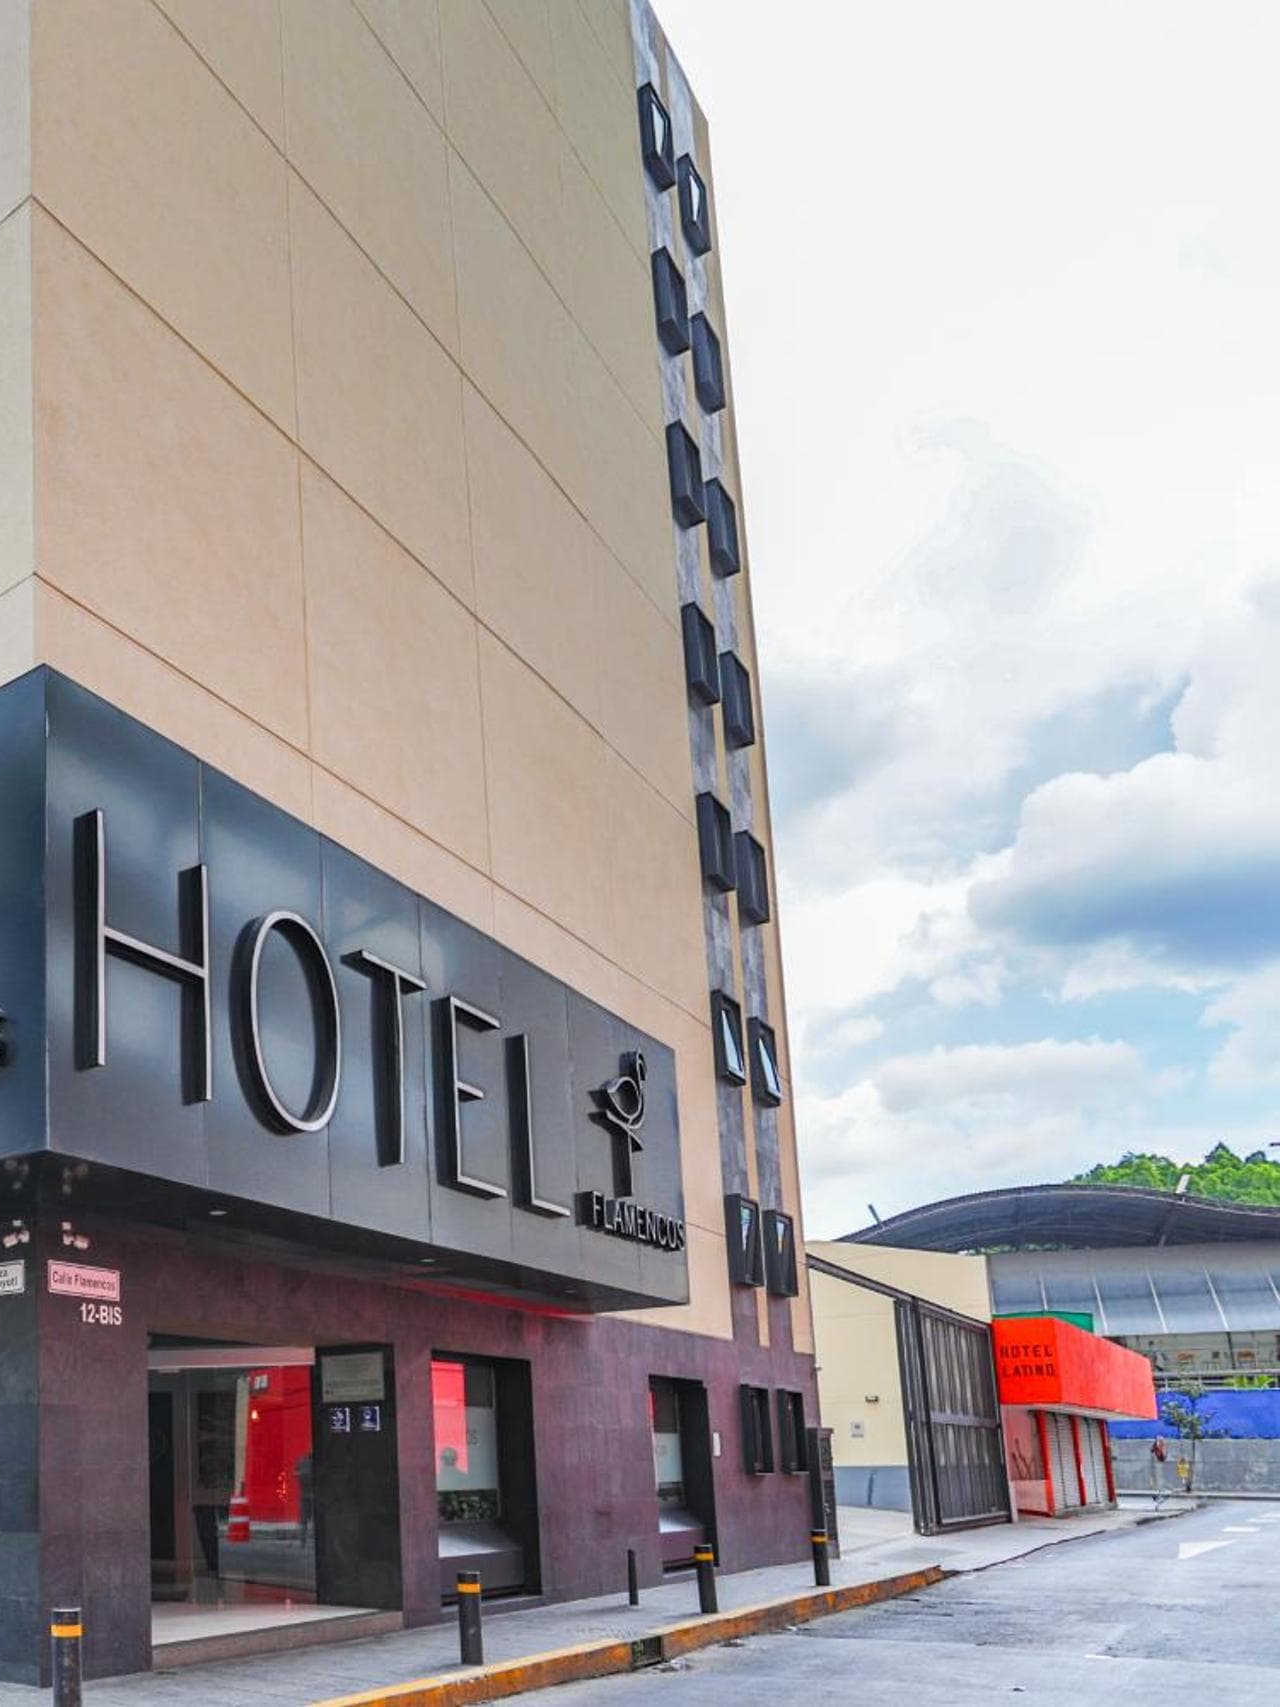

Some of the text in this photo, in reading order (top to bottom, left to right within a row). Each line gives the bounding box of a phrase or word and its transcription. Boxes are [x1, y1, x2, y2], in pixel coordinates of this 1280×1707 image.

[74, 808, 570, 1217] HOTEL
[591, 1190, 685, 1251] FLAMENCOS
[80, 1302, 122, 1325] 12-BIS
[1001, 1344, 1053, 1358] HOTEL
[1003, 1363, 1056, 1378] LATINO
